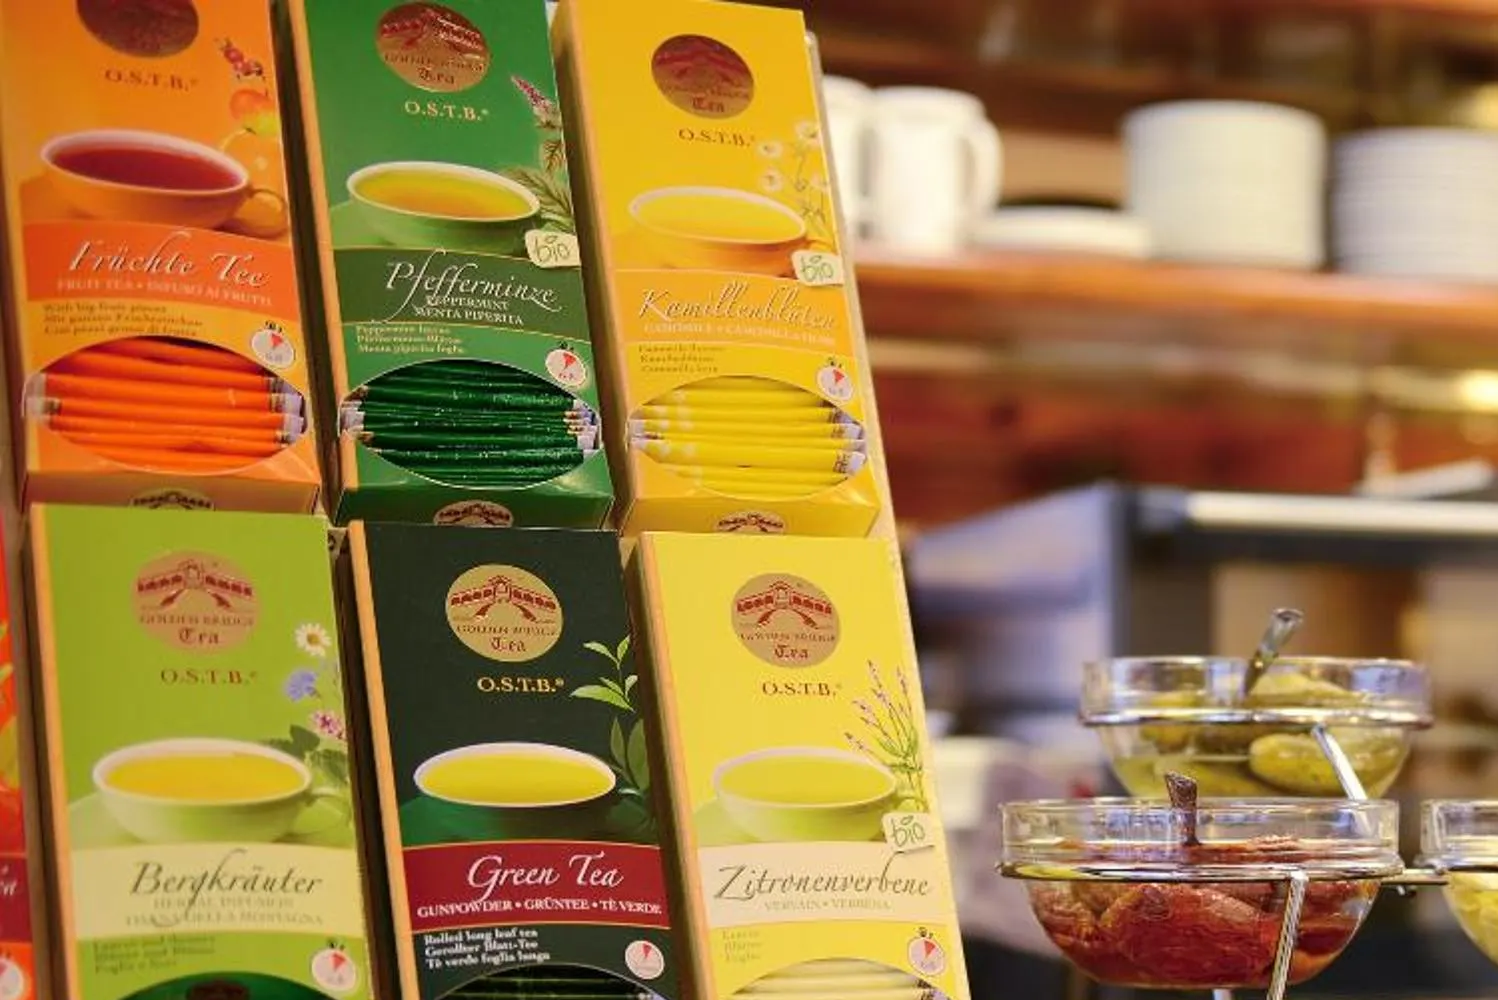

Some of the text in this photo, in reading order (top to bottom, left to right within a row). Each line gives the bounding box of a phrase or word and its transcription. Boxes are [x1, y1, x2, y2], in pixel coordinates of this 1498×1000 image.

[68, 230, 270, 287] Früchte Tee
[534, 236, 571, 264] bio
[374, 248, 563, 324] Pfefferminze
[414, 306, 525, 326] MENTA PIPERITA
[130, 848, 325, 928] Bergkräuter
[467, 850, 625, 902] Green Tea
[713, 850, 931, 902] Zitronenverbene
[417, 896, 663, 919] GUNPOWDER GRÜNTEE TÈ VERDE
